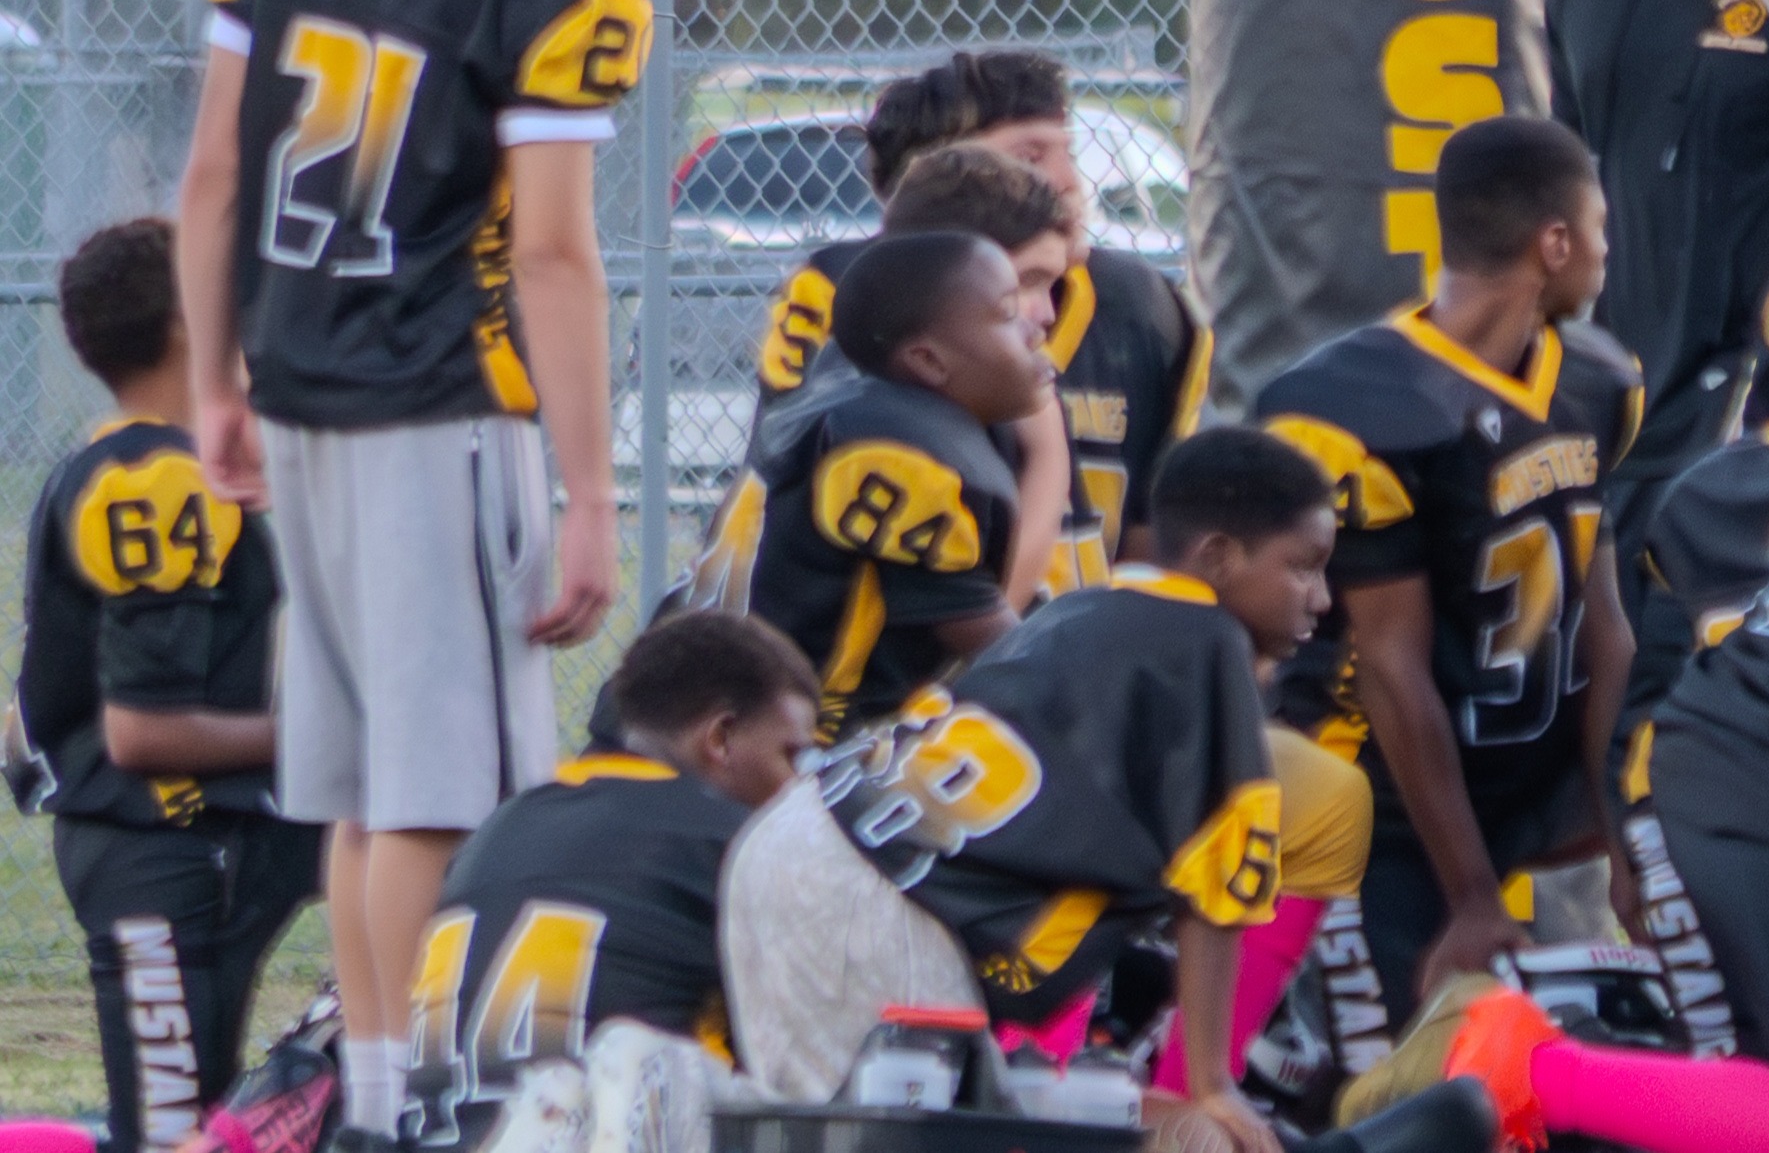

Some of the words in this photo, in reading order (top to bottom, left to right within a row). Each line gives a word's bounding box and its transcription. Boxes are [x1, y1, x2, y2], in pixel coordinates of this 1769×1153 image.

[259, 13, 428, 278] 21
[106, 492, 218, 583] 64
[837, 469, 955, 569] 84
[405, 900, 608, 1149] 44
